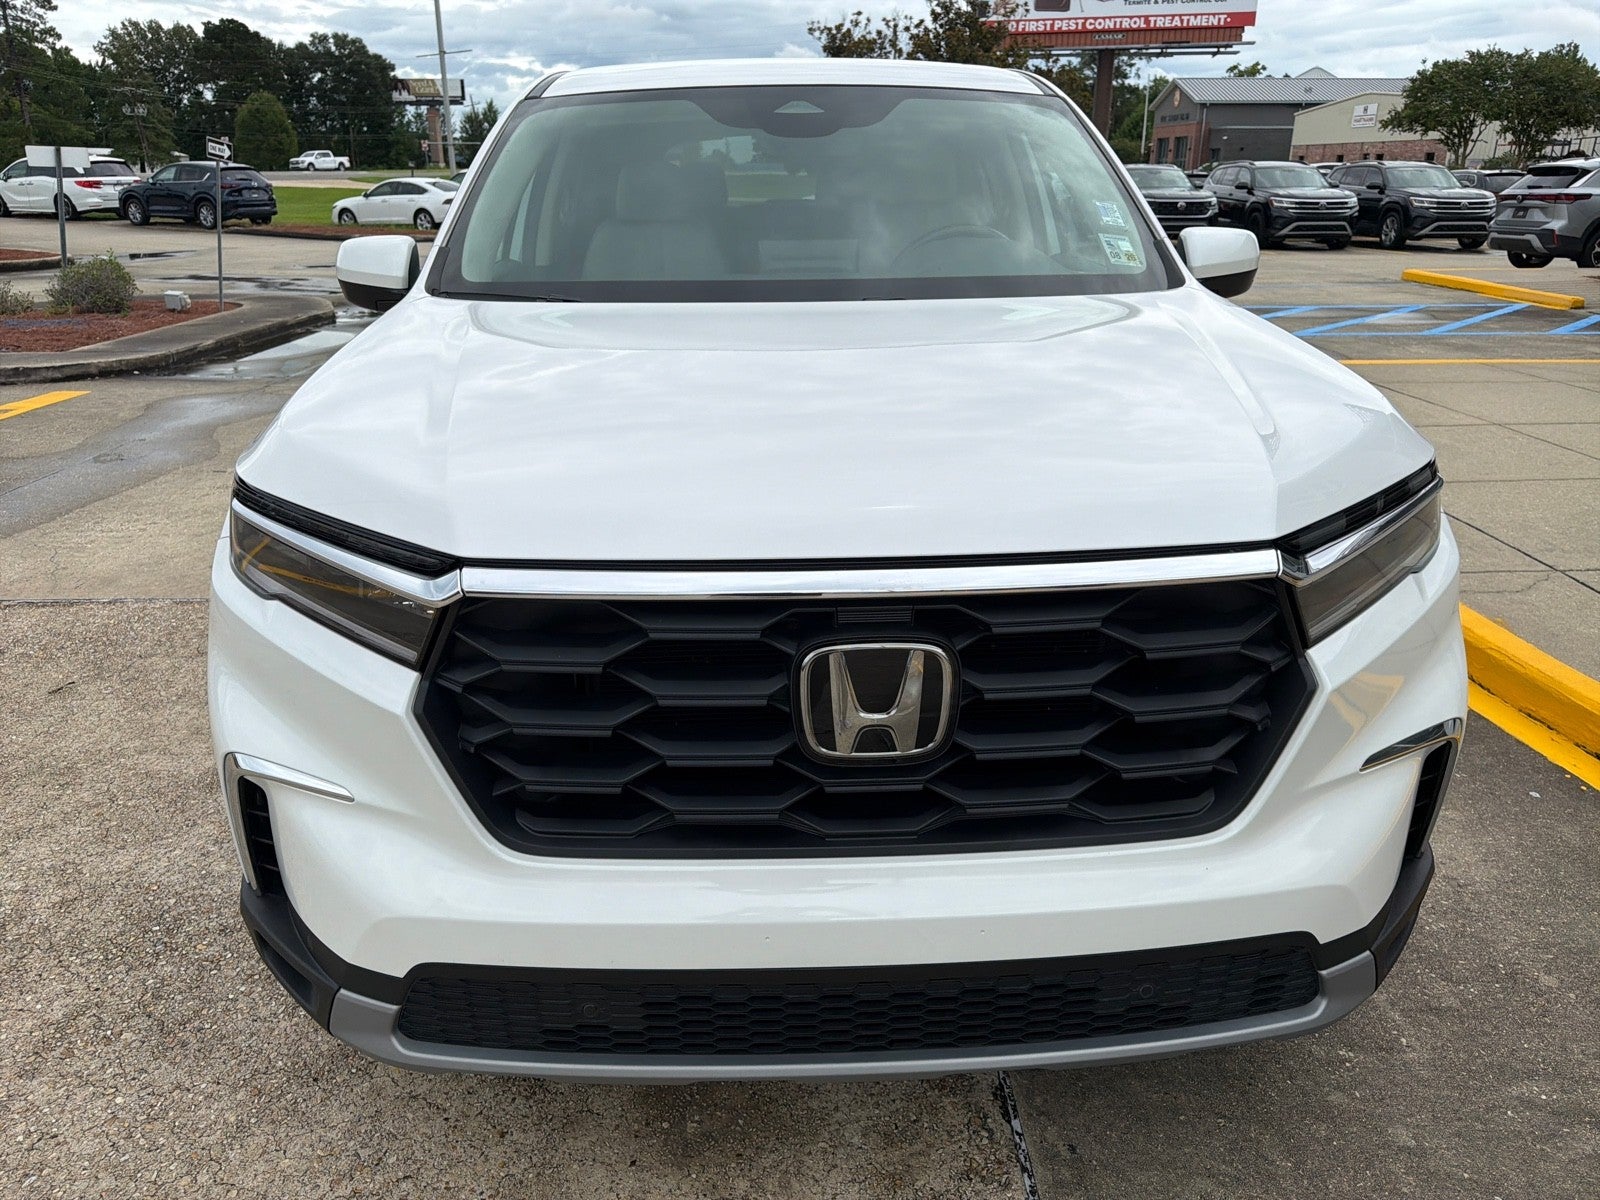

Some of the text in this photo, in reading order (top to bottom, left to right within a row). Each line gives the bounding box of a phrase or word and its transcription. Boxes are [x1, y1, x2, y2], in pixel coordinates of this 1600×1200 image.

[1018, 20, 1053, 32] FIRST
[1054, 19, 1085, 31] PEST
[1086, 17, 1147, 30] CONTROL
